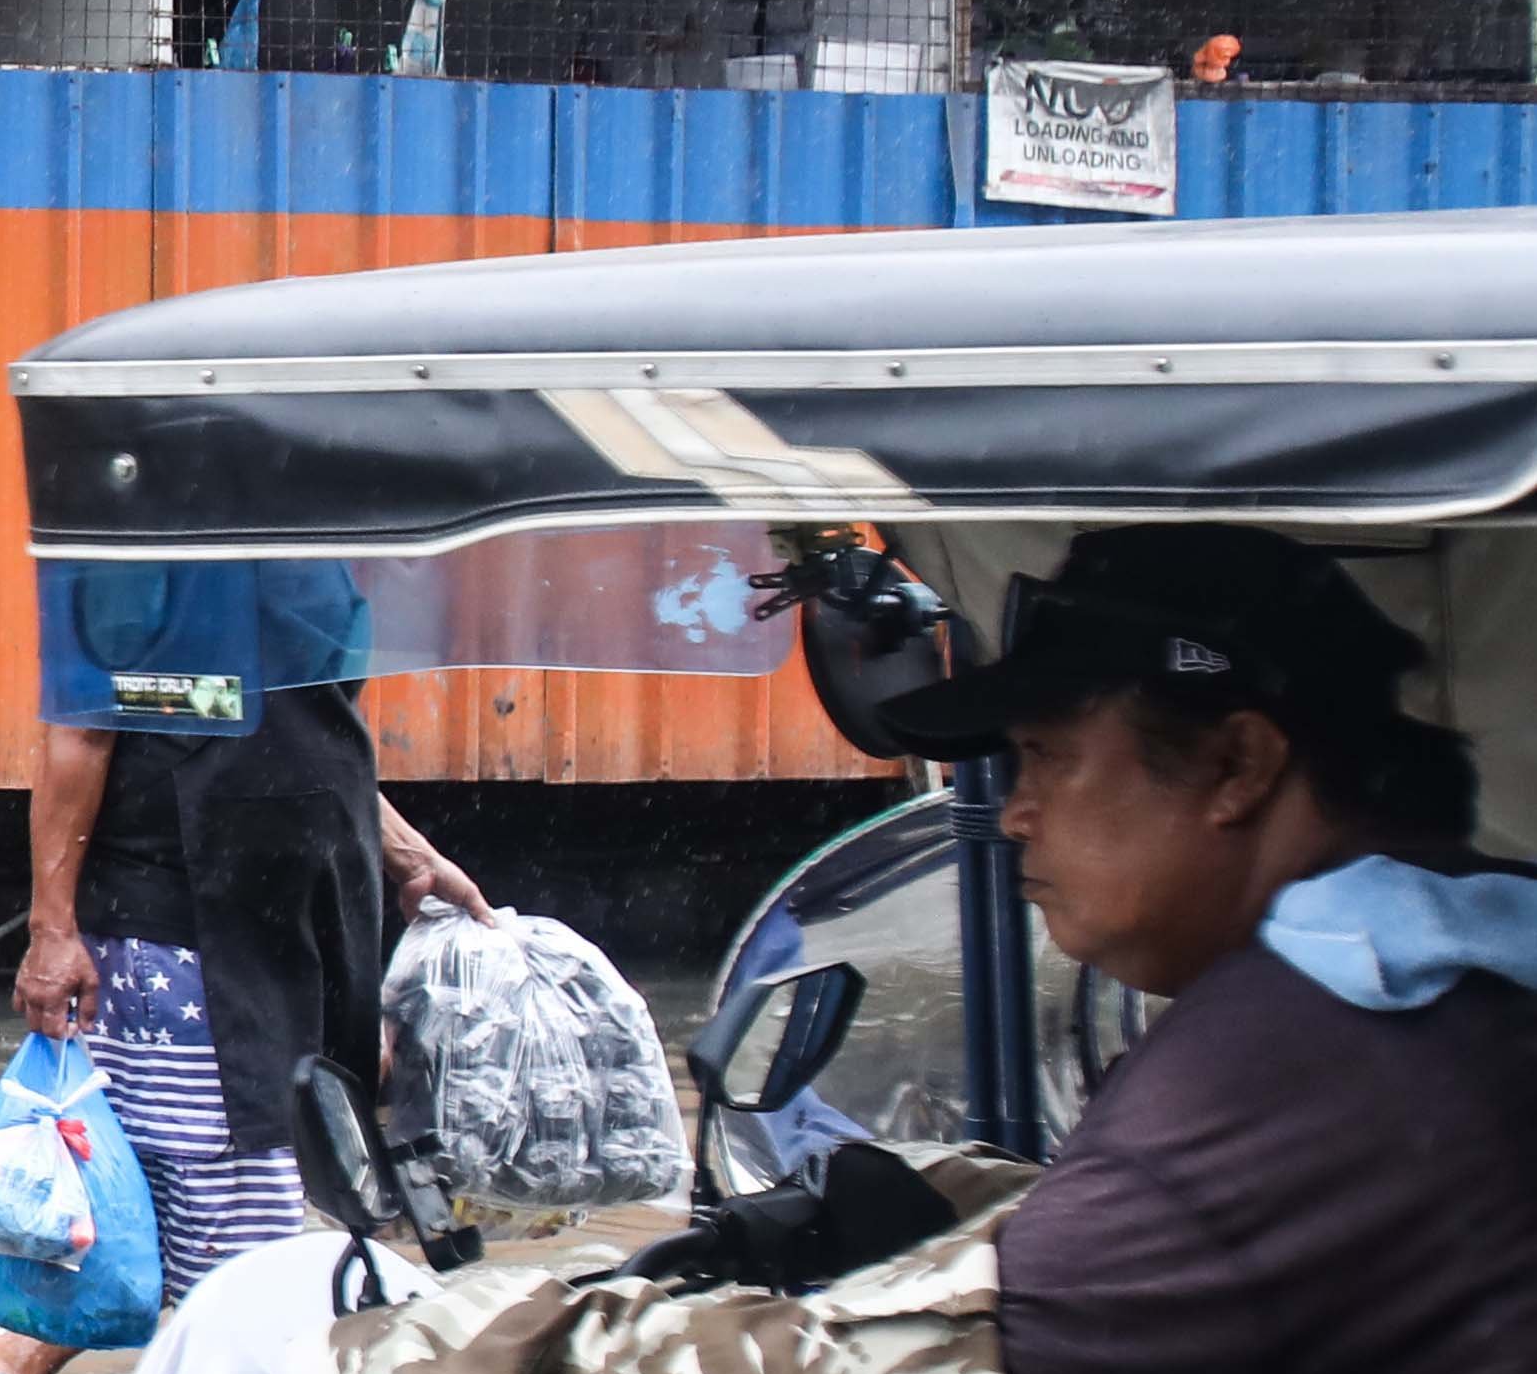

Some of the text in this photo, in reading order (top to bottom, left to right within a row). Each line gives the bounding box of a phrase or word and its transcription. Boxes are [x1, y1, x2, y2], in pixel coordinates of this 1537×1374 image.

[1014, 118, 1149, 149] LOADING AND
[1023, 144, 1141, 171] UNLOADING
